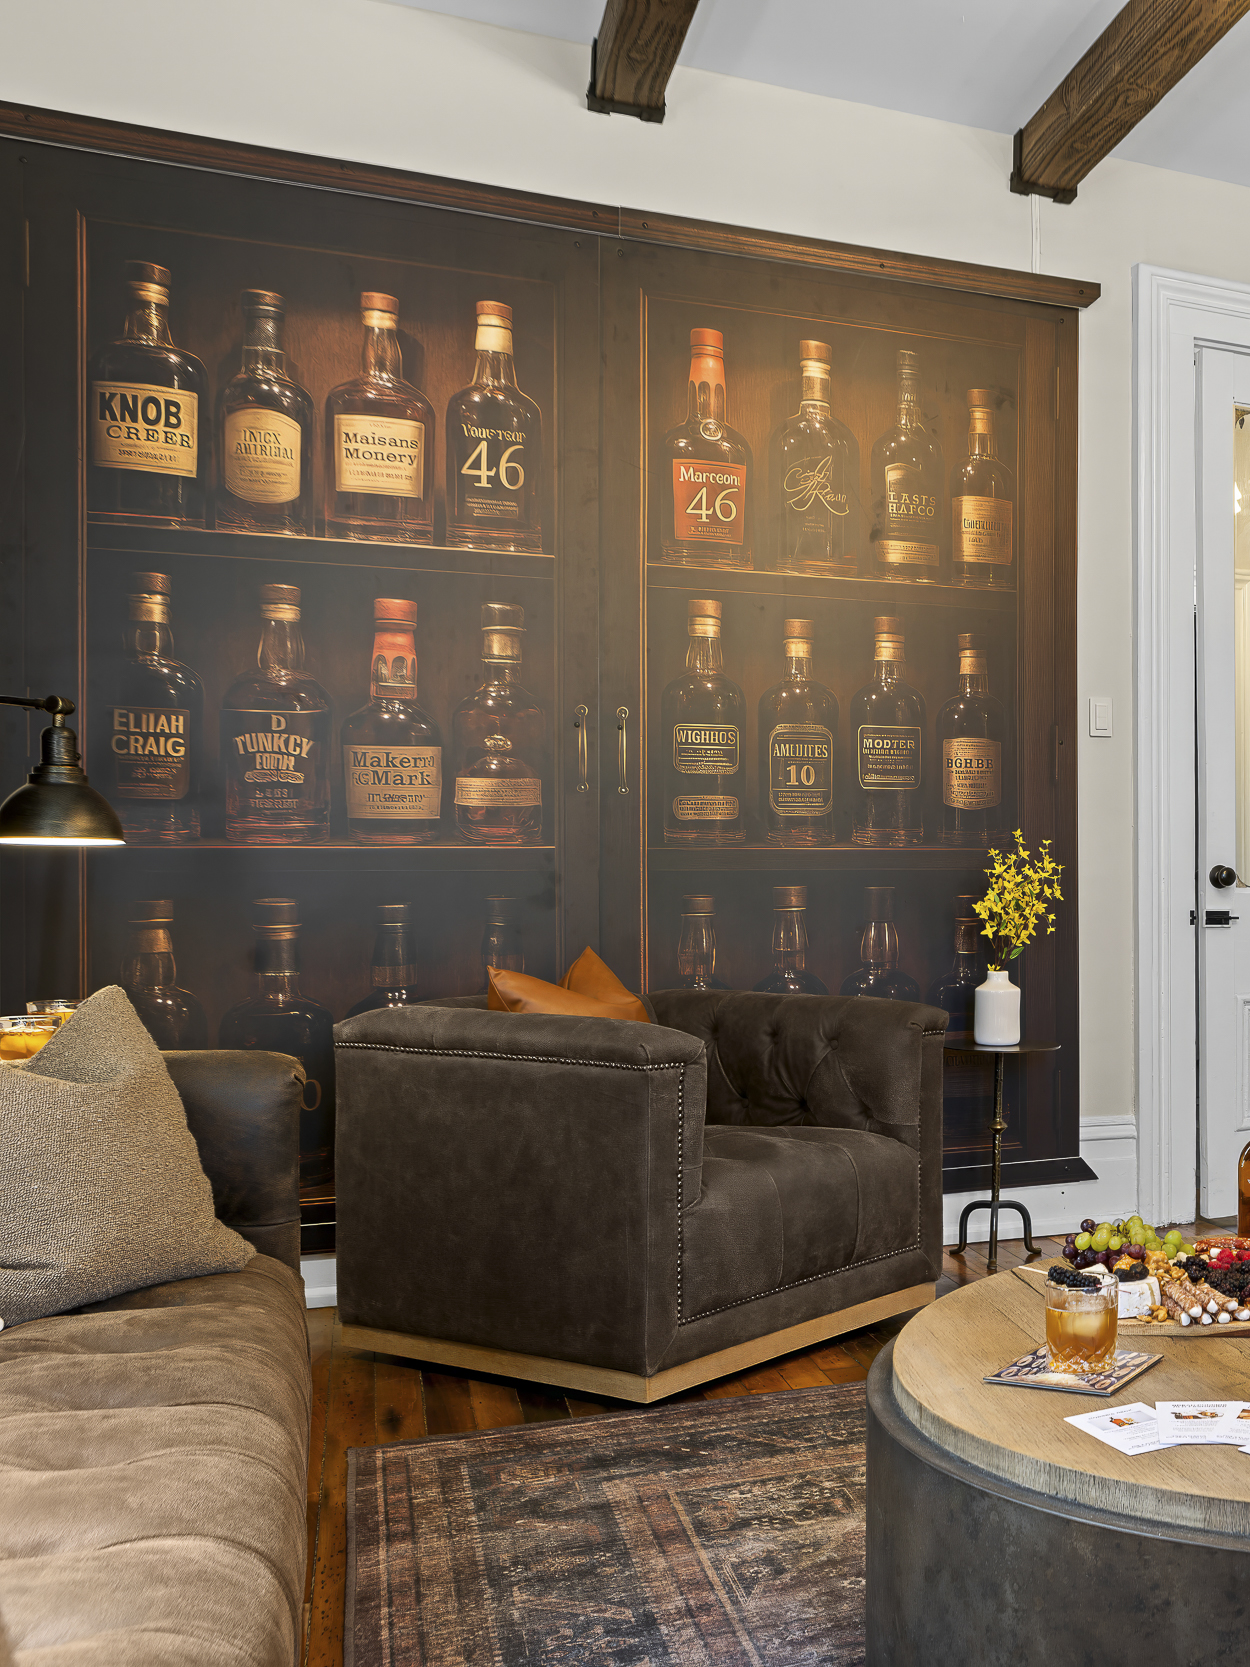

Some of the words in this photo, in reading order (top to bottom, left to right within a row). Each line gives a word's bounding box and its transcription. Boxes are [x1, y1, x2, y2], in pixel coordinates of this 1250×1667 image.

[99, 391, 182, 429] KNOB
[342, 431, 419, 450] Maisans
[343, 446, 418, 466] Monery
[460, 440, 525, 490] 46
[685, 486, 739, 522] 46
[271, 713, 287, 731] D
[111, 734, 186, 757] CRAIG
[786, 764, 816, 786] 10
